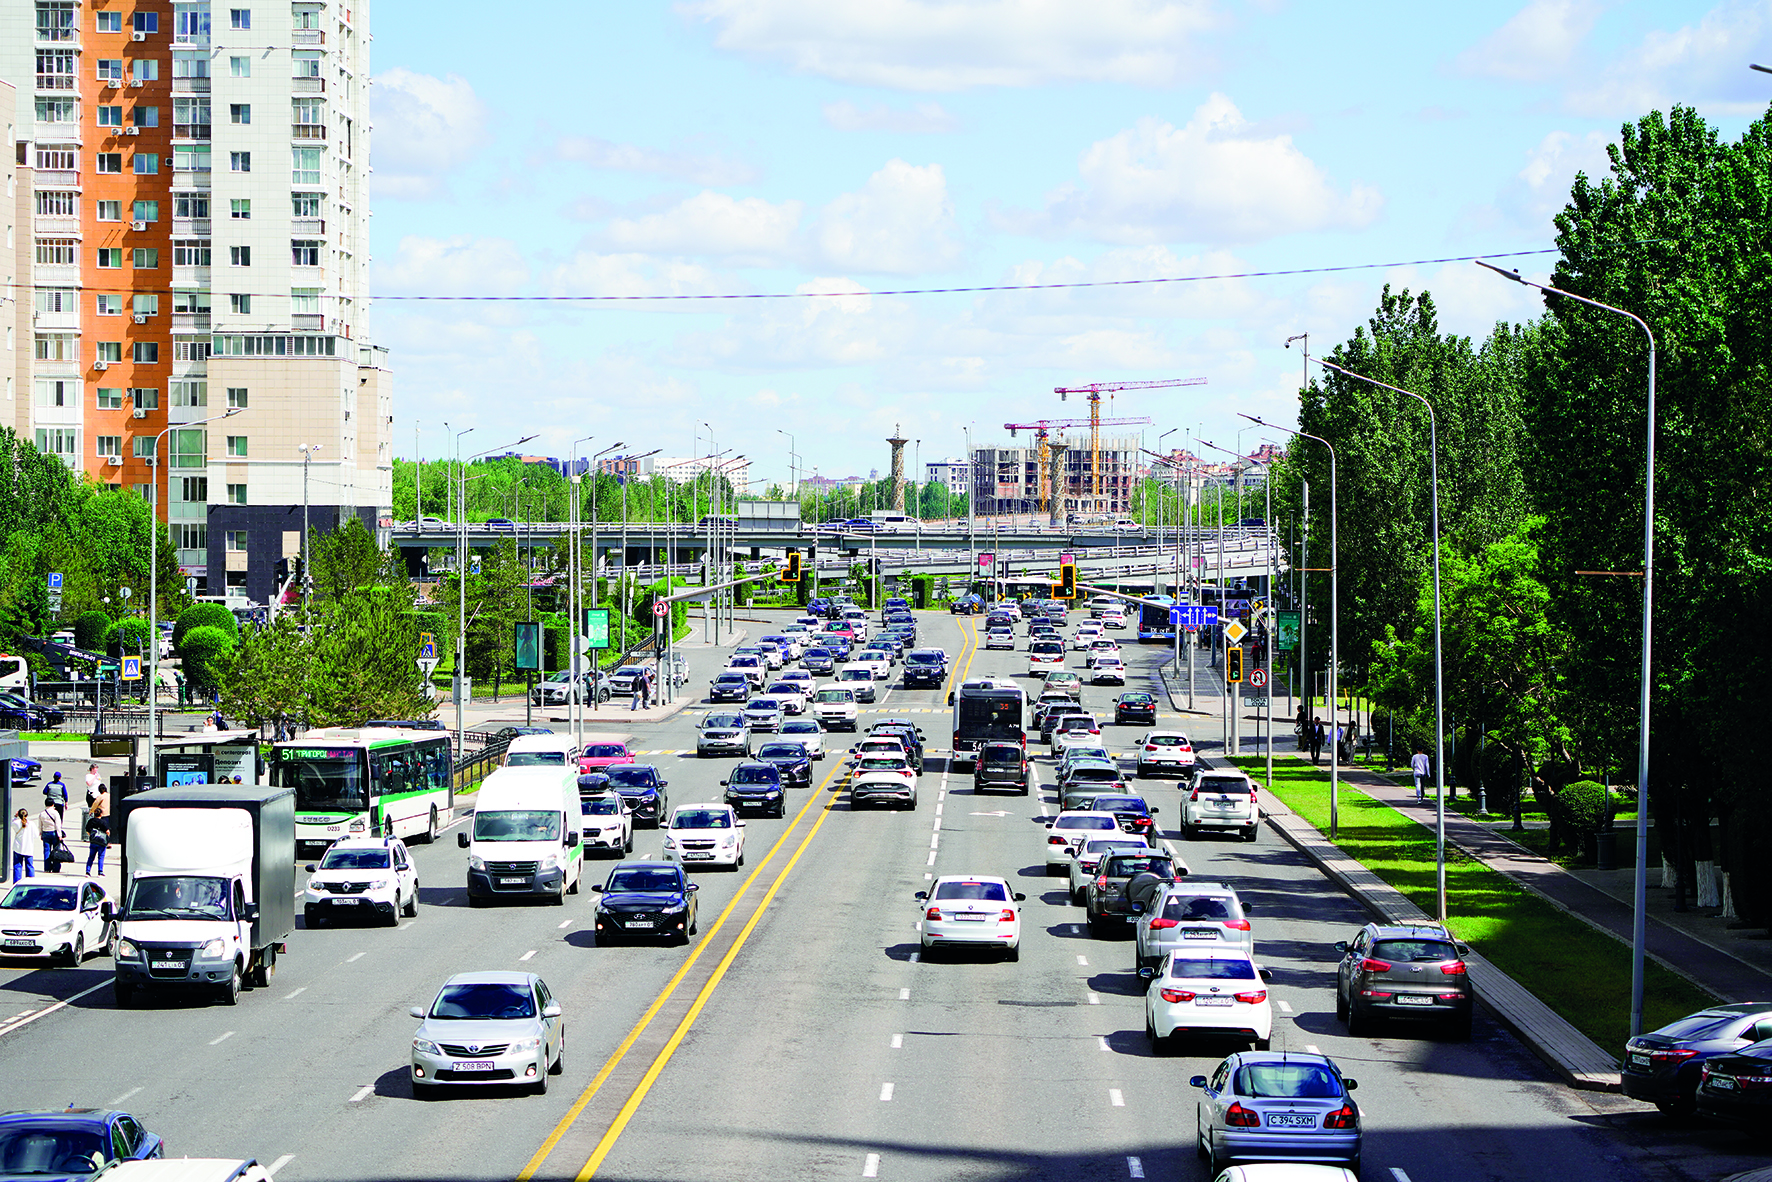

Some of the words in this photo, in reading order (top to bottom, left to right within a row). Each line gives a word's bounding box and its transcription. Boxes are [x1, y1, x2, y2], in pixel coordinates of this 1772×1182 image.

[282, 749, 294, 761] 51
[455, 1062, 461, 1071] Z
[462, 1062, 475, 1070] 508
[476, 1062, 492, 1070] BPN
[1270, 1115, 1277, 1125] C
[1278, 1115, 1294, 1125] 394
[1295, 1115, 1313, 1125] SXM
